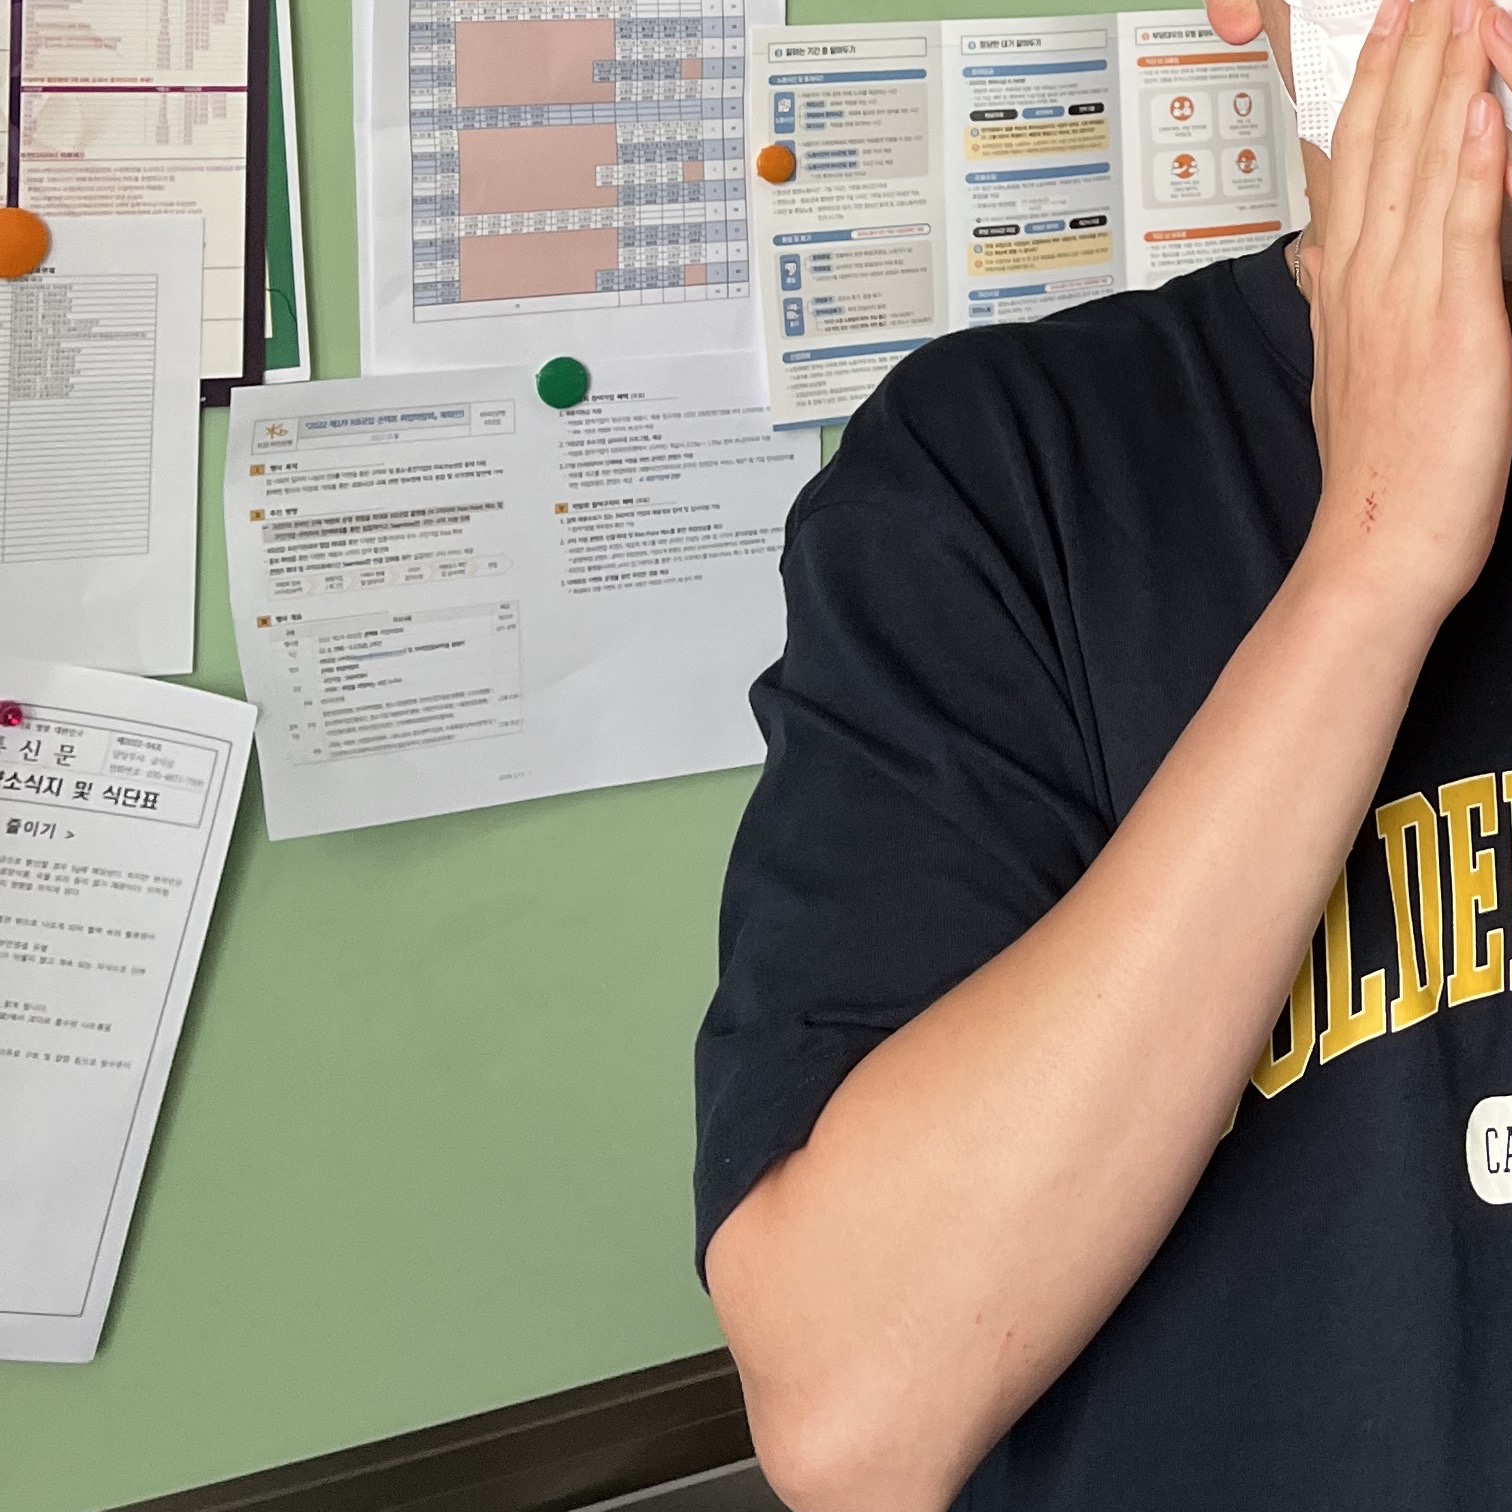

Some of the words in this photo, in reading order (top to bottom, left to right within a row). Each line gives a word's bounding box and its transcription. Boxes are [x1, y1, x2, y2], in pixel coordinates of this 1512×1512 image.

[20, 739, 42, 763] 신
[55, 744, 77, 768] 문
[0, 770, 63, 797] 소식지
[71, 780, 94, 802] 및
[102, 785, 161, 812] 식단표
[5, 817, 58, 840] 줄이기
